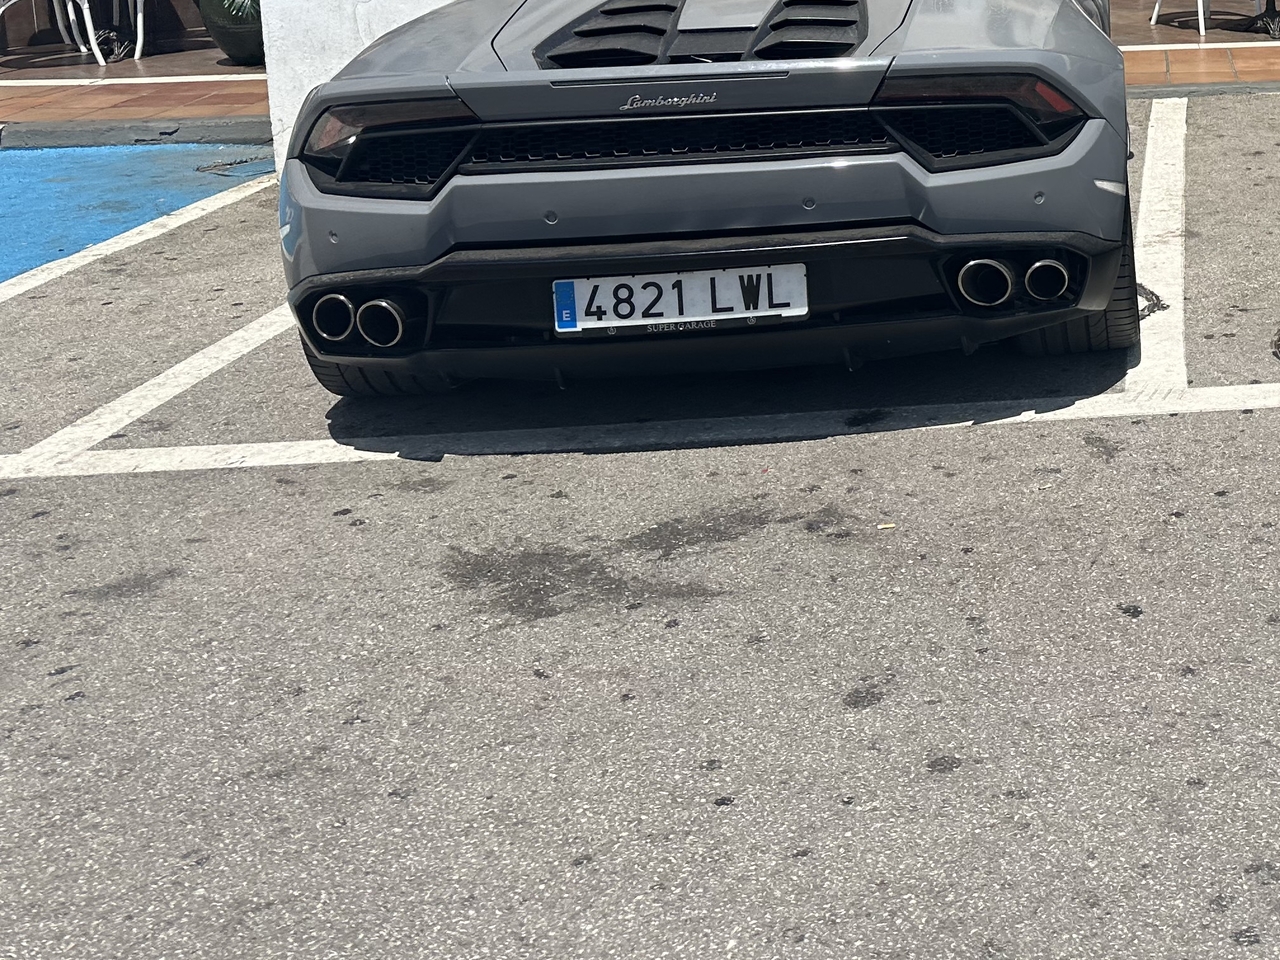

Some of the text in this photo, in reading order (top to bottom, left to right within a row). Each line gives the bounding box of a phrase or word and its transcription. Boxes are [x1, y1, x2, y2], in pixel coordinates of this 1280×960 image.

[619, 92, 718, 111] Lamborghini
[562, 272, 791, 321] E 4821 LWL
[647, 320, 717, 333] SUPER GARAGE
